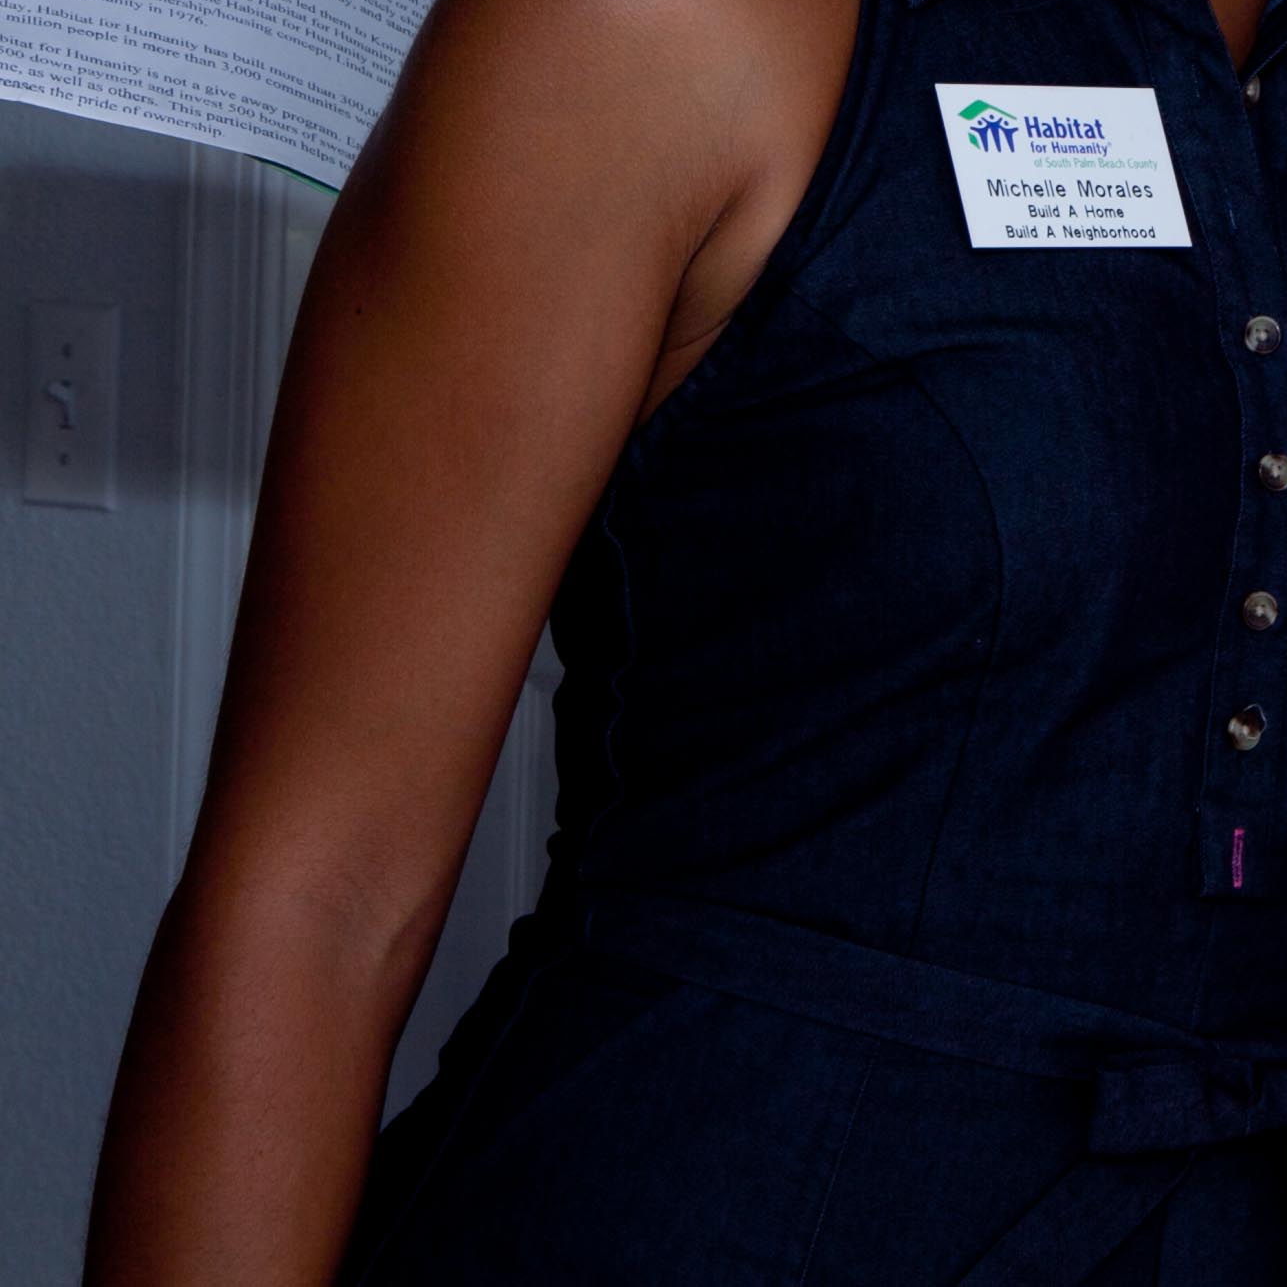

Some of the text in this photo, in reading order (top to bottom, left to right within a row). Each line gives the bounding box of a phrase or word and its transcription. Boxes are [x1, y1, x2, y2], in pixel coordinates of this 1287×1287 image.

[148, 3, 163, 14] in
[168, 7, 208, 26] 1976.
[358, 4, 382, 21] and
[394, 0, 408, 12] or
[320, 8, 351, 29] them
[354, 24, 367, 37] to
[36, 4, 93, 24] Habitat
[98, 16, 121, 30] for
[124, 23, 199, 52] Humanity
[202, 43, 229, 58] has
[231, 51, 265, 70] built
[268, 67, 304, 85] more
[306, 79, 336, 99] than
[275, 30, 332, 61] concept,
[335, 53, 373, 79] Linda
[281, 17, 301, 33] for
[304, 27, 367, 65] Humanity
[311, 17, 331, 33] for
[333, 28, 396, 69] Humanity
[5, 14, 350, 119] million people in more than 3,000 communities
[28, 52, 73, 71] down
[77, 66, 145, 90] payment
[147, 84, 174, 96] and
[179, 90, 224, 110] invest
[226, 102, 256, 119] 500
[259, 113, 299, 135] hours
[302, 132, 318, 144] of
[39, 42, 62, 55] for
[65, 48, 142, 77] Humanity
[146, 67, 160, 79] is
[163, 74, 188, 87] not
[191, 82, 200, 90] a
[203, 85, 237, 100] give
[240, 96, 278, 117] away
[281, 110, 341, 141] program.
[0, 79, 226, 139] eases the pride of ownership.
[27, 68, 45, 78] as
[49, 74, 82, 87] well
[86, 82, 104, 92] as
[107, 87, 159, 106] others.
[166, 99, 201, 116] This
[205, 111, 296, 147] participation
[299, 141, 335, 164] helps
[1024, 117, 1104, 139] Habitat
[1031, 141, 1107, 156] for Humanity
[1034, 157, 1157, 169] of South Palm Beach County
[987, 179, 1152, 198] Michelle Morales
[1028, 205, 1124, 218] Build A Home
[1006, 225, 1155, 240] Build A Neighborhood
